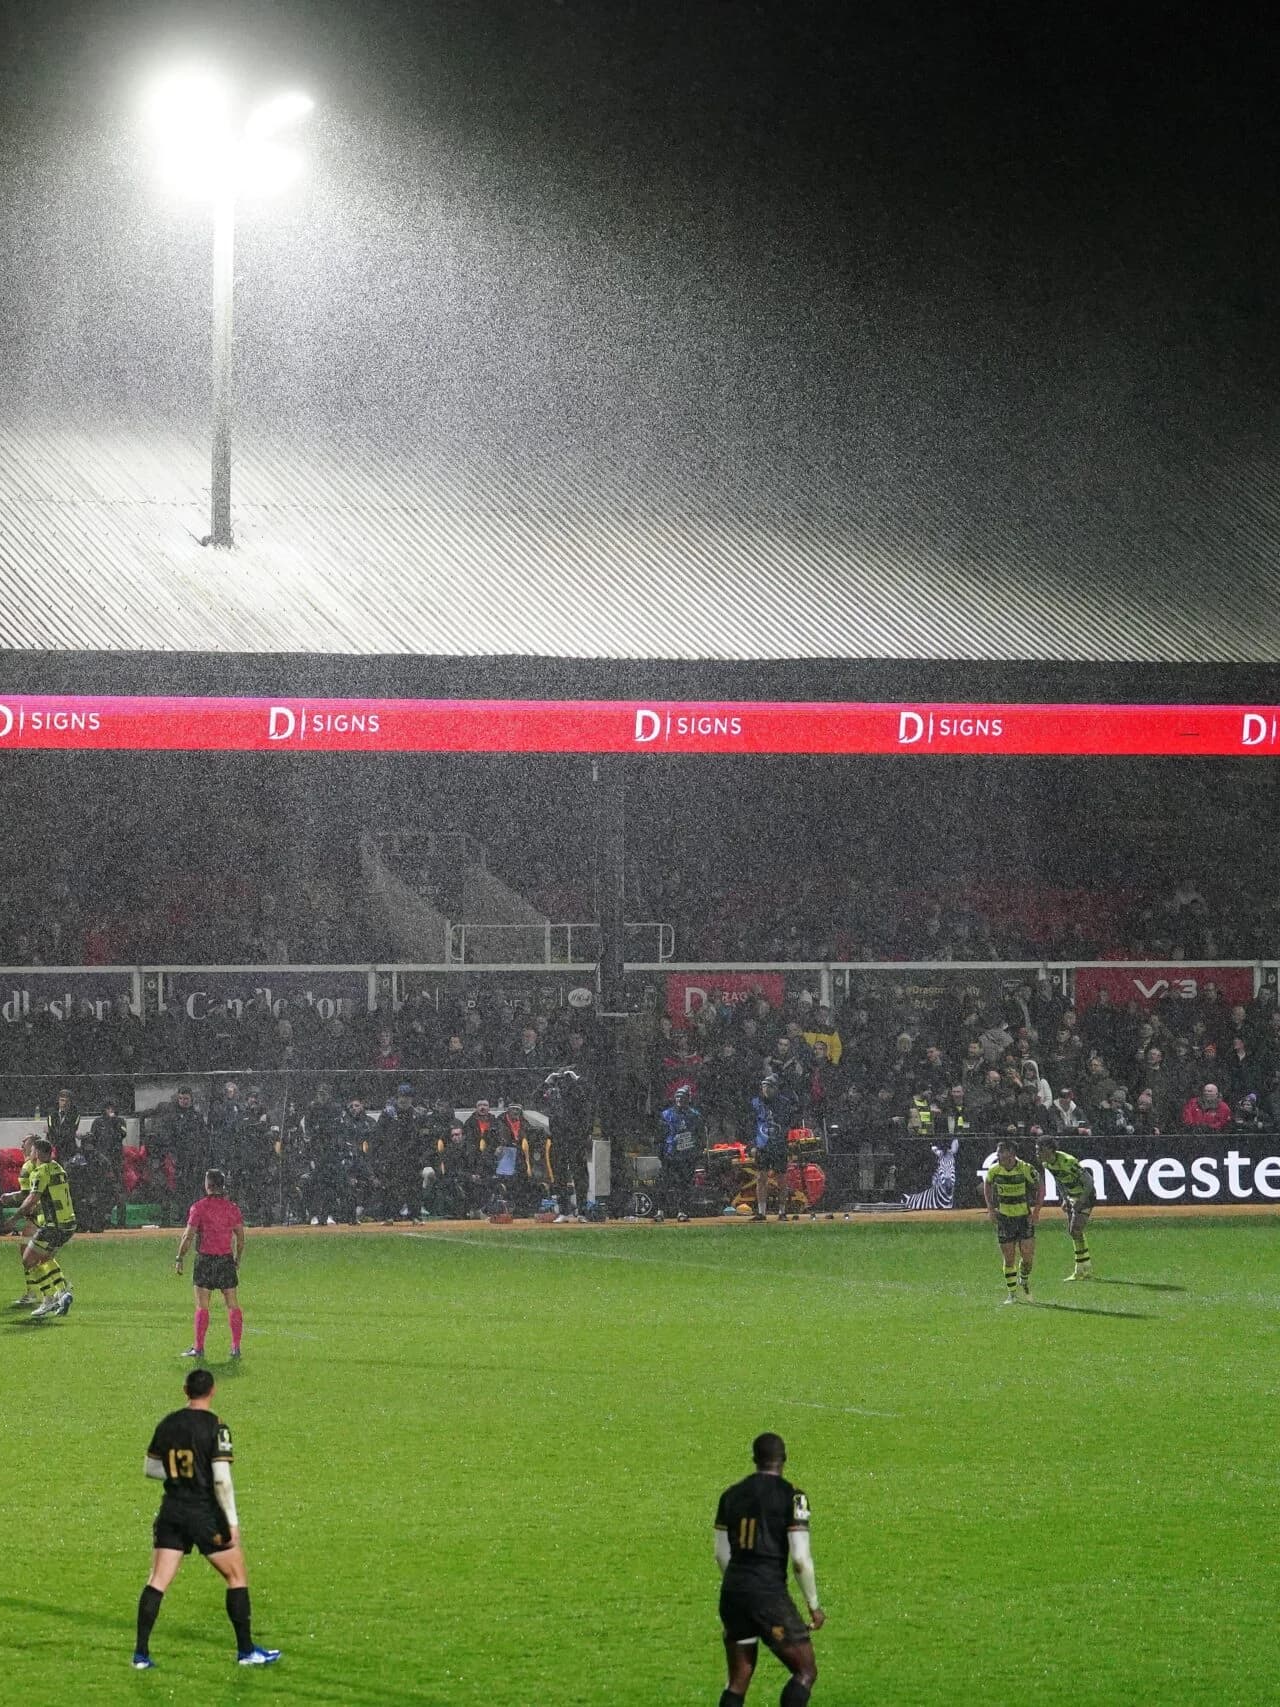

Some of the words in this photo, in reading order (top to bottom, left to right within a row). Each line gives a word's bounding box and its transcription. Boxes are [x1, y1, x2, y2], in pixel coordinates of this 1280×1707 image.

[31, 712, 100, 730] SIGNS
[313, 715, 380, 732] SIGNS
[677, 717, 741, 734] SIGNS
[940, 719, 1002, 736] SIGNS
[168, 1448, 195, 1479] 13
[738, 1517, 758, 1550] 11
